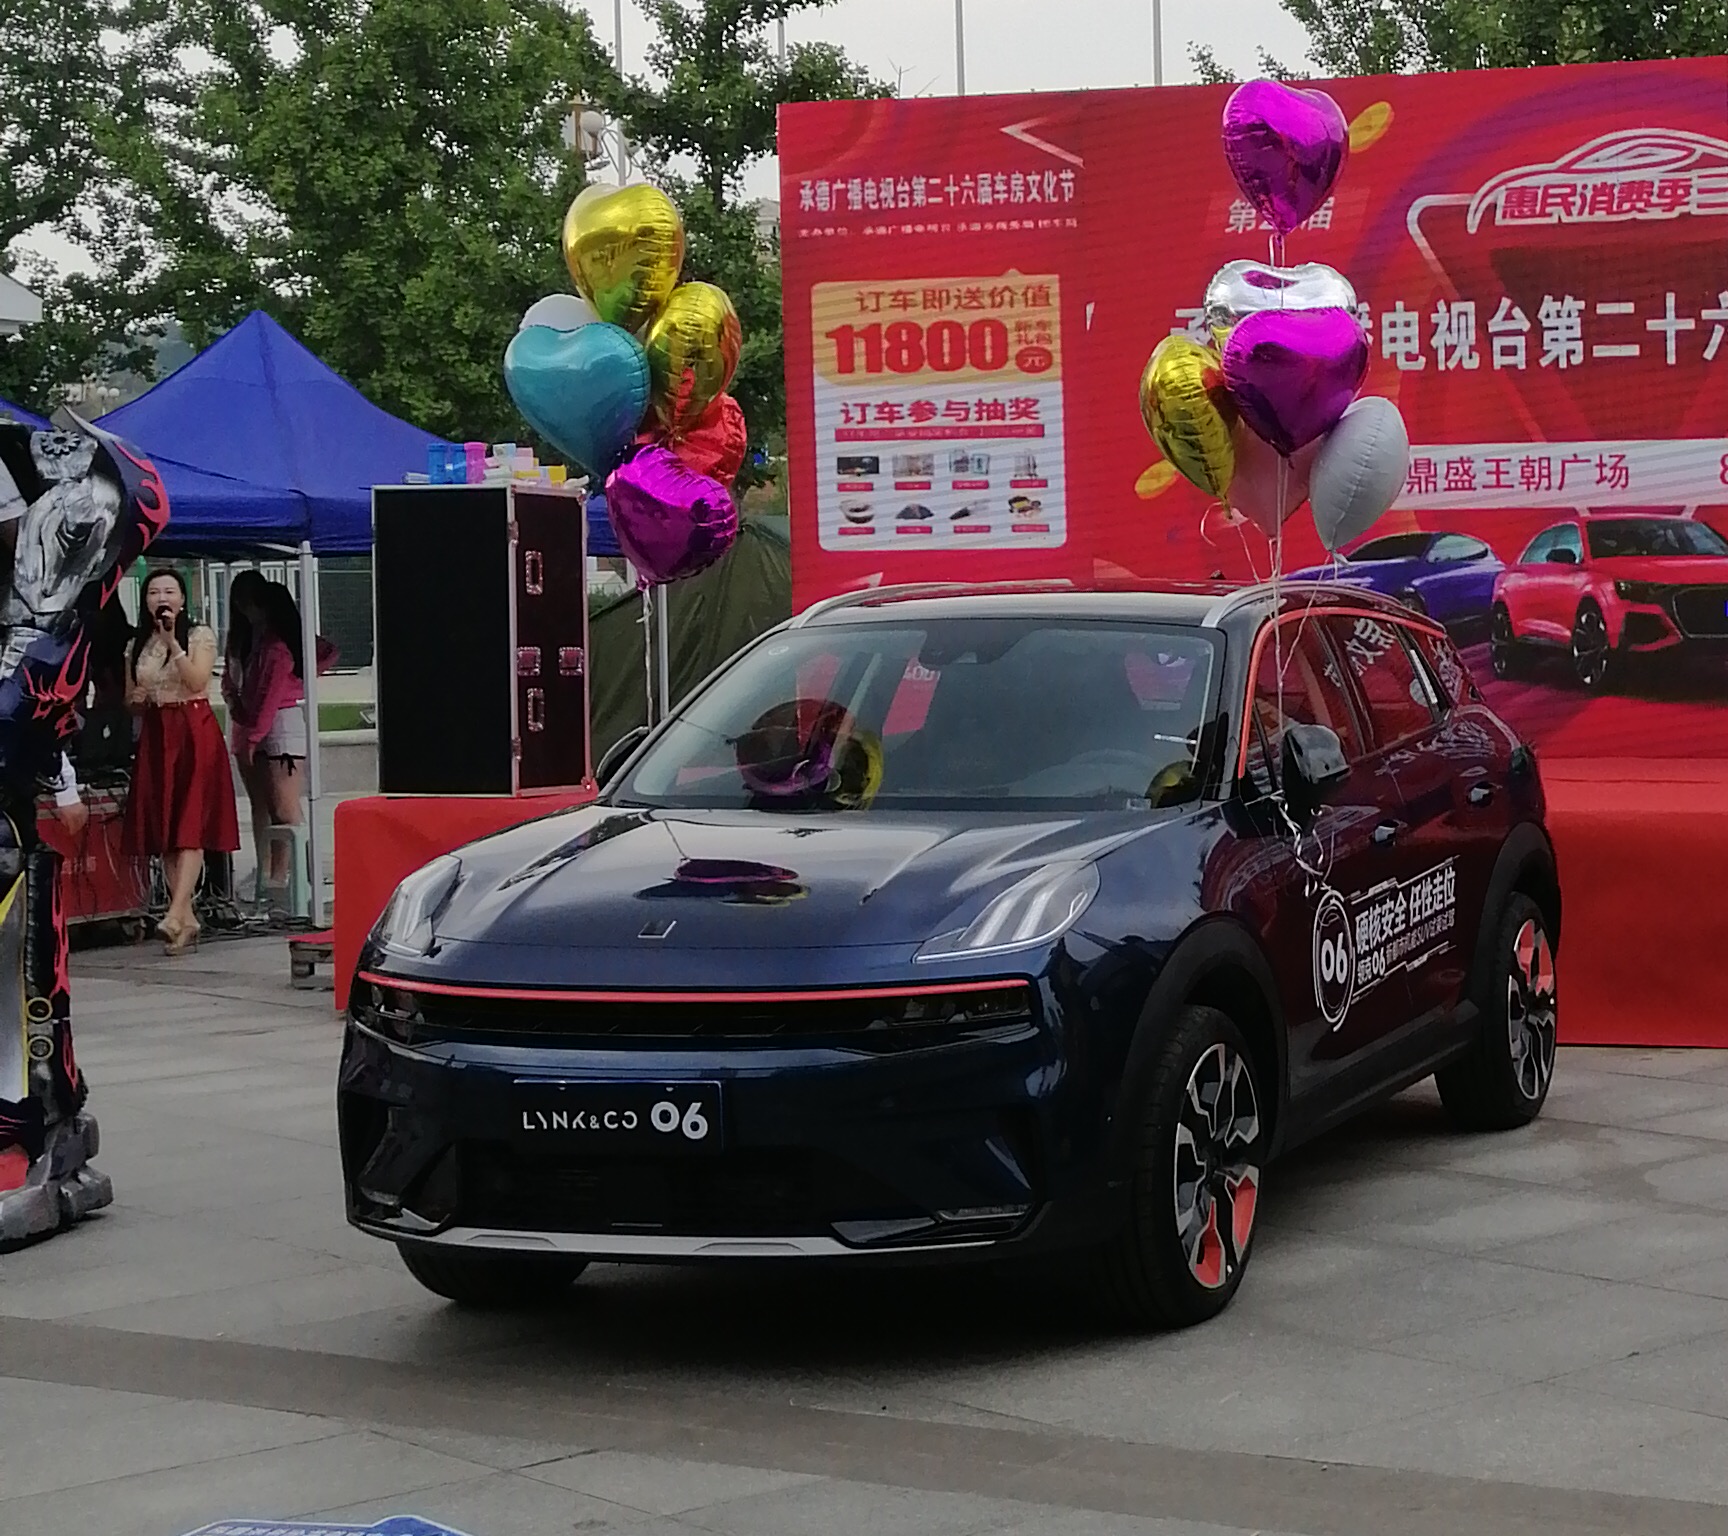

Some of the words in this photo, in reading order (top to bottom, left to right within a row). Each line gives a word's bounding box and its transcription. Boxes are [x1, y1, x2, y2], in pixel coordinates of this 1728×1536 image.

[798, 168, 1076, 213] 承德广播电视台第二十六届车房文化节
[1502, 175, 1693, 220] 惠民消费季
[855, 284, 1053, 314] 订车即送价值
[825, 318, 1009, 374] 11800
[839, 397, 1041, 425] 订车参与抽奖
[1406, 452, 1630, 494] 鼎盛王朝广场
[1409, 867, 1456, 926] 任性走位
[1320, 932, 1348, 984] 06
[650, 1101, 709, 1140] 06
